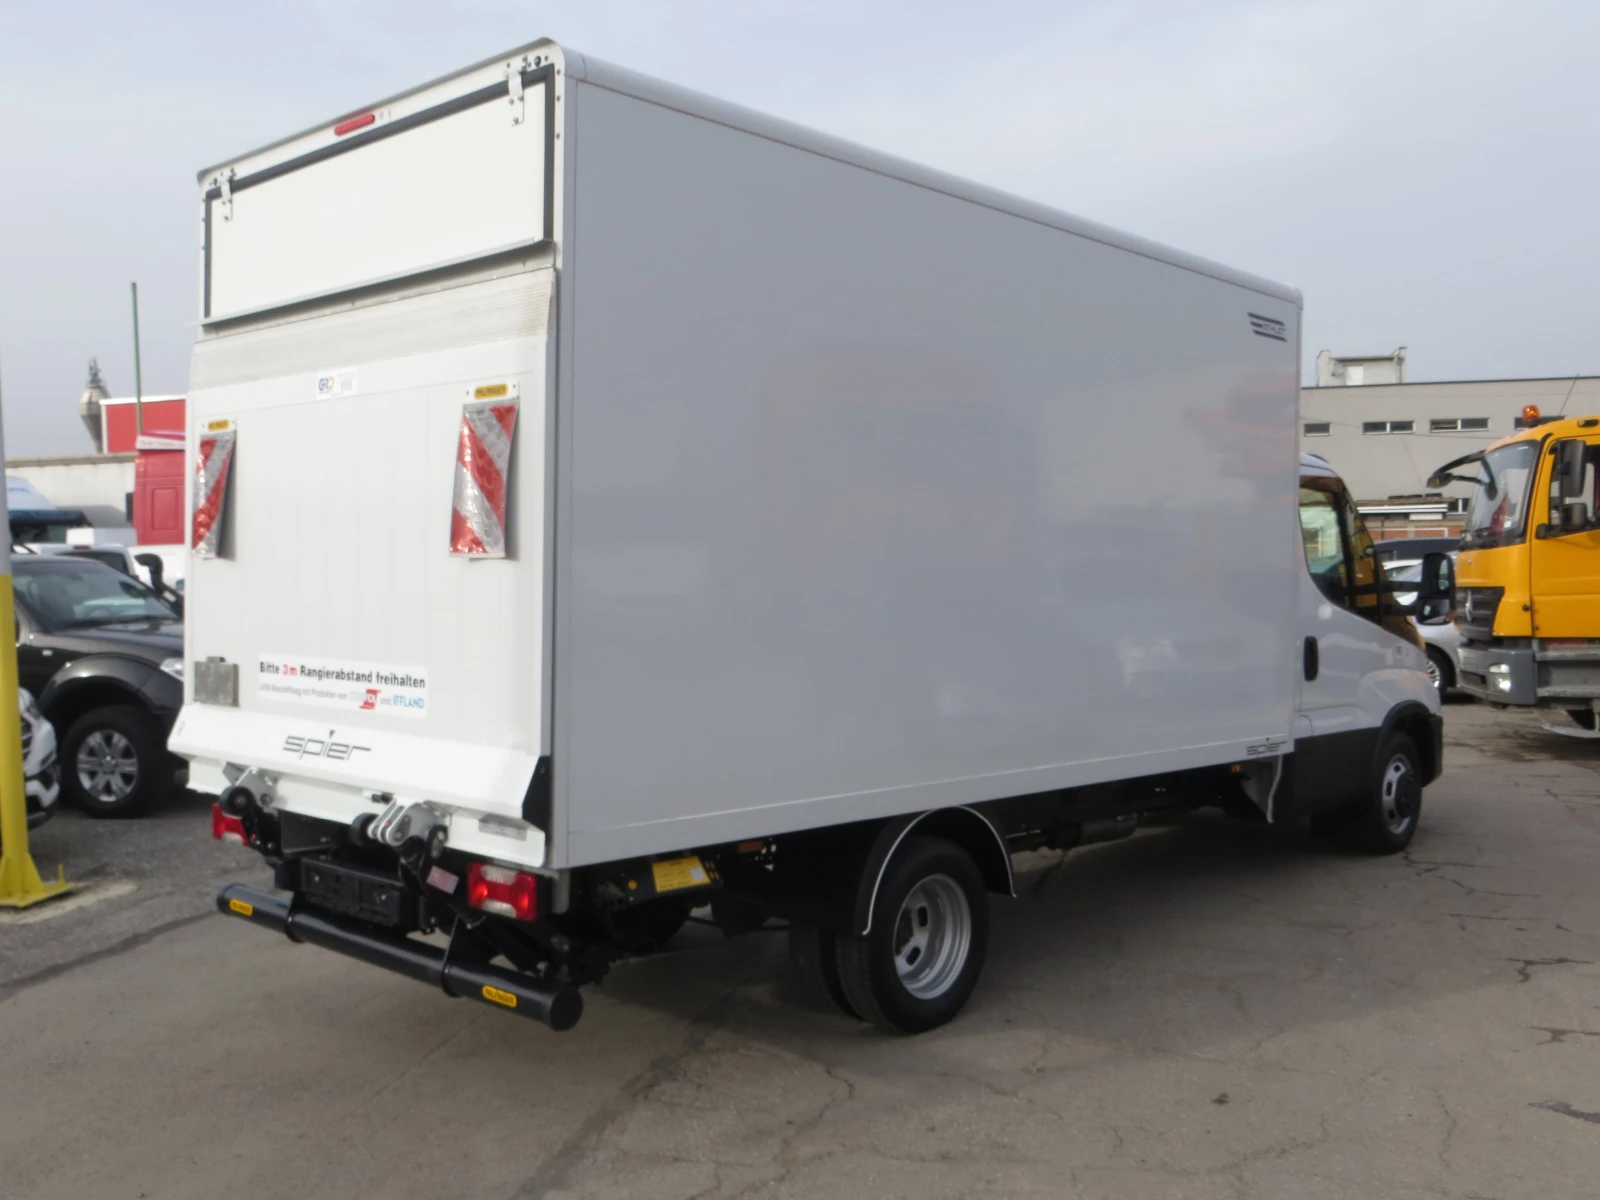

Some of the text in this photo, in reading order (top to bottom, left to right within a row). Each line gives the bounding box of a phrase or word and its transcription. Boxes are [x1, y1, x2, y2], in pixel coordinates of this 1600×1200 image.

[259, 661, 280, 675] Bitte
[300, 665, 373, 683] Rangierabstand
[376, 672, 426, 689] freihalten
[380, 696, 391, 705] und
[393, 694, 425, 709] IFFLAND
[283, 729, 372, 760] spier
[1246, 737, 1288, 756] spier
